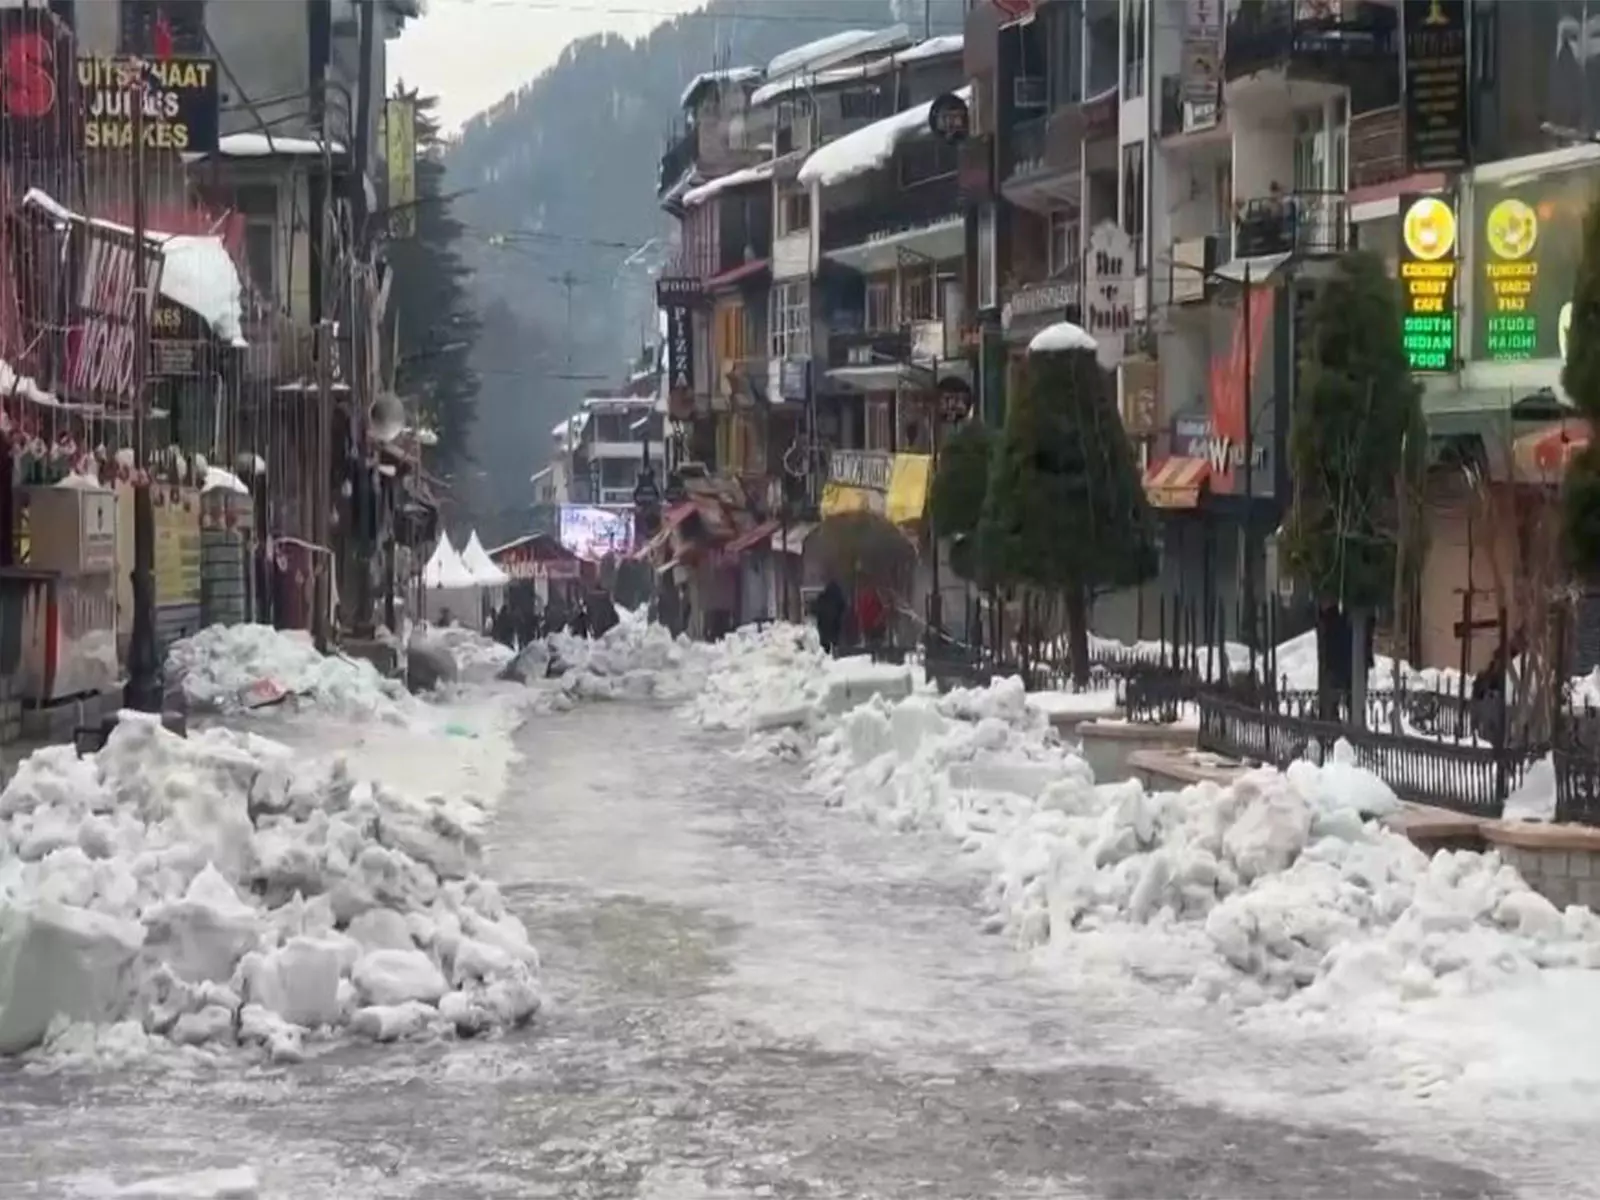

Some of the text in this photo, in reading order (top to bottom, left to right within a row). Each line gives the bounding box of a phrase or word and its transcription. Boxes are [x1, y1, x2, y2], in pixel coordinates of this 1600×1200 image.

[141, 61, 212, 87] HAAT
[85, 123, 189, 148] SHAKES
[1403, 317, 1452, 332] SOUTH
[674, 307, 688, 387] PIZZA
[1403, 334, 1452, 350] INDIAN
[1409, 353, 1446, 368] FOOD
